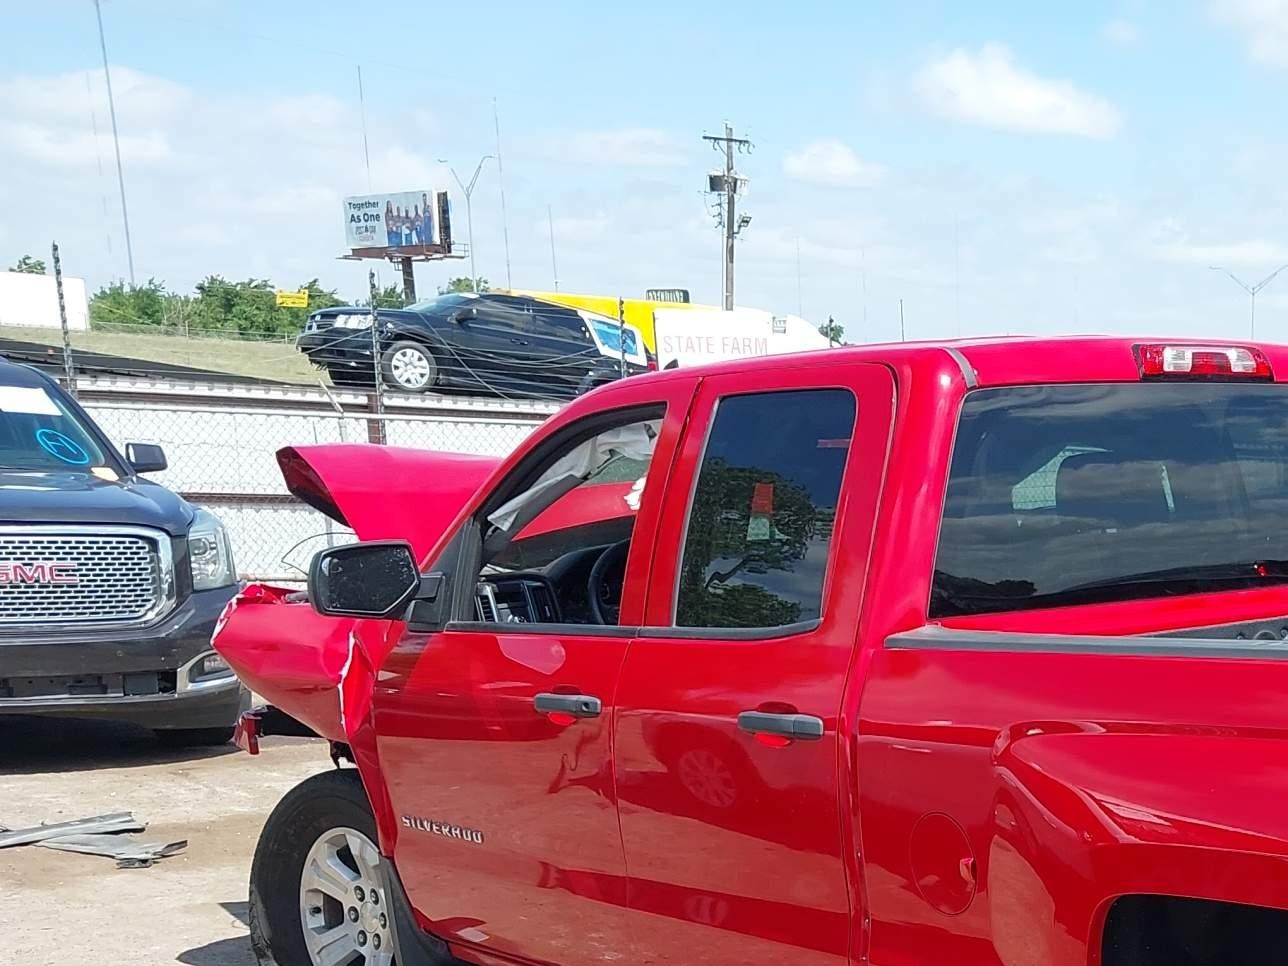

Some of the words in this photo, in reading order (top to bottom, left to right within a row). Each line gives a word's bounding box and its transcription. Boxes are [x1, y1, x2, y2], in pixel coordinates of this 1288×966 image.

[348, 200, 379, 211] Together
[350, 213, 362, 223] As
[362, 212, 381, 222] One
[663, 335, 715, 355] STATE
[722, 336, 769, 356] FARM
[401, 816, 483, 844] SILVERADO
